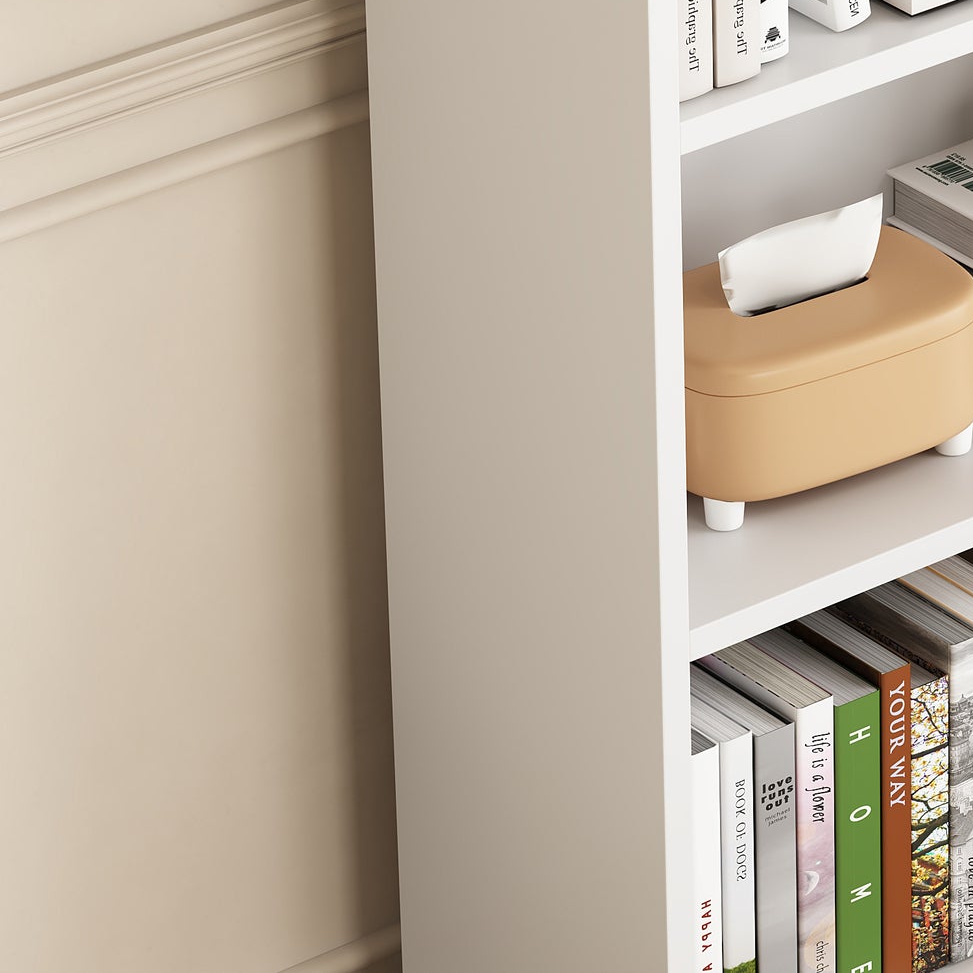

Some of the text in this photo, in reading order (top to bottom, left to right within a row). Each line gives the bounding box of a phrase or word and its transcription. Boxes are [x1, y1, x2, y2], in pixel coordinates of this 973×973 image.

[889, 680, 906, 807] YOUR WAY
[762, 776, 793, 794] love
[805, 732, 831, 823] life is a flower
[761, 784, 793, 804] runs
[765, 795, 790, 812] out
